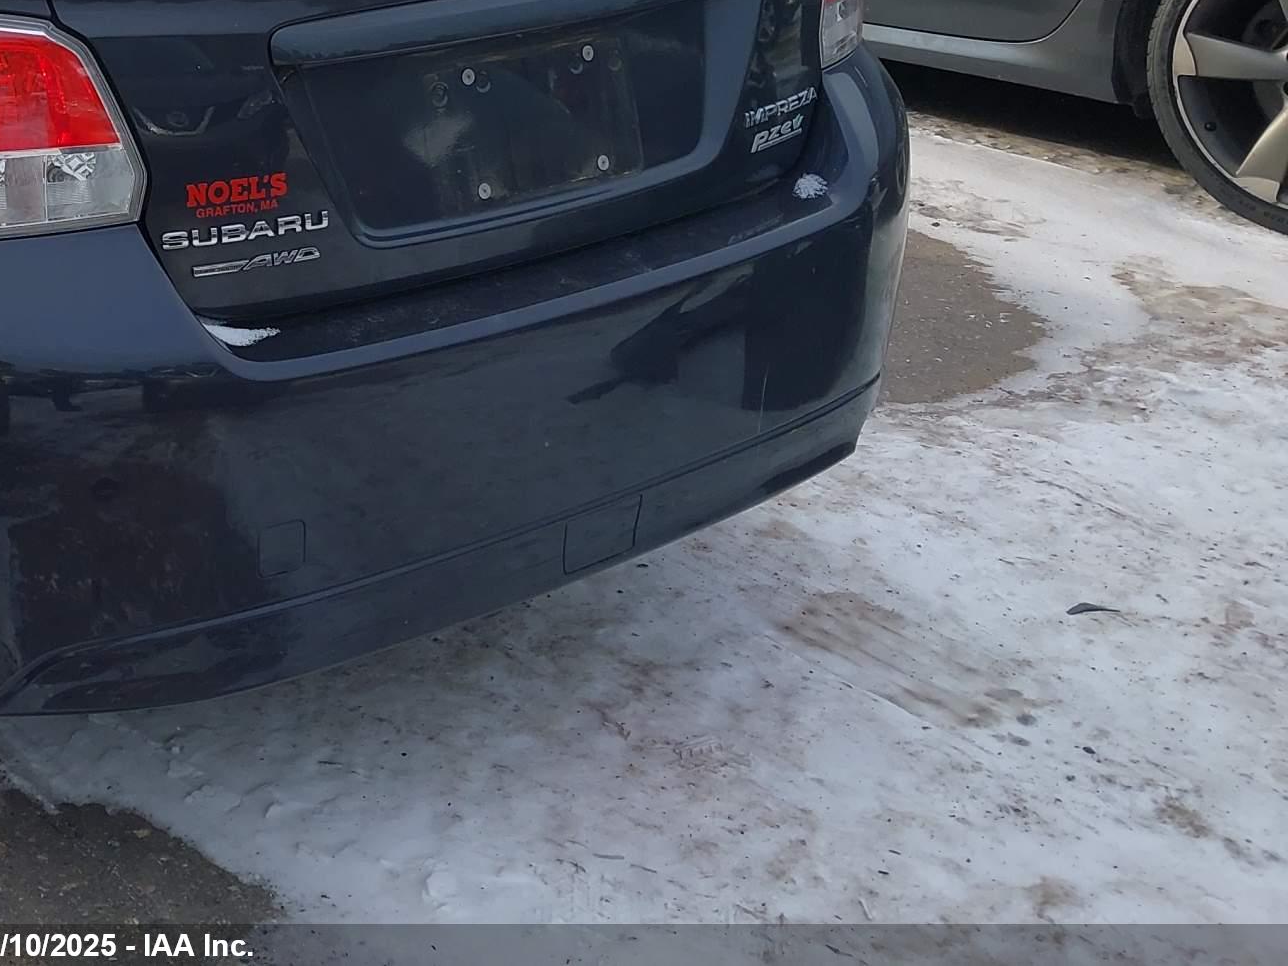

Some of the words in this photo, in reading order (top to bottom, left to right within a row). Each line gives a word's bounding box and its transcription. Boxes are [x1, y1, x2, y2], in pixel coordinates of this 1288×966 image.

[744, 86, 817, 128] IMPREZA
[186, 173, 288, 207] NOEL'S
[196, 201, 258, 218] GRAFTON,
[260, 199, 279, 210] MA
[162, 210, 329, 251] SUBARU
[242, 246, 321, 272] AWD
